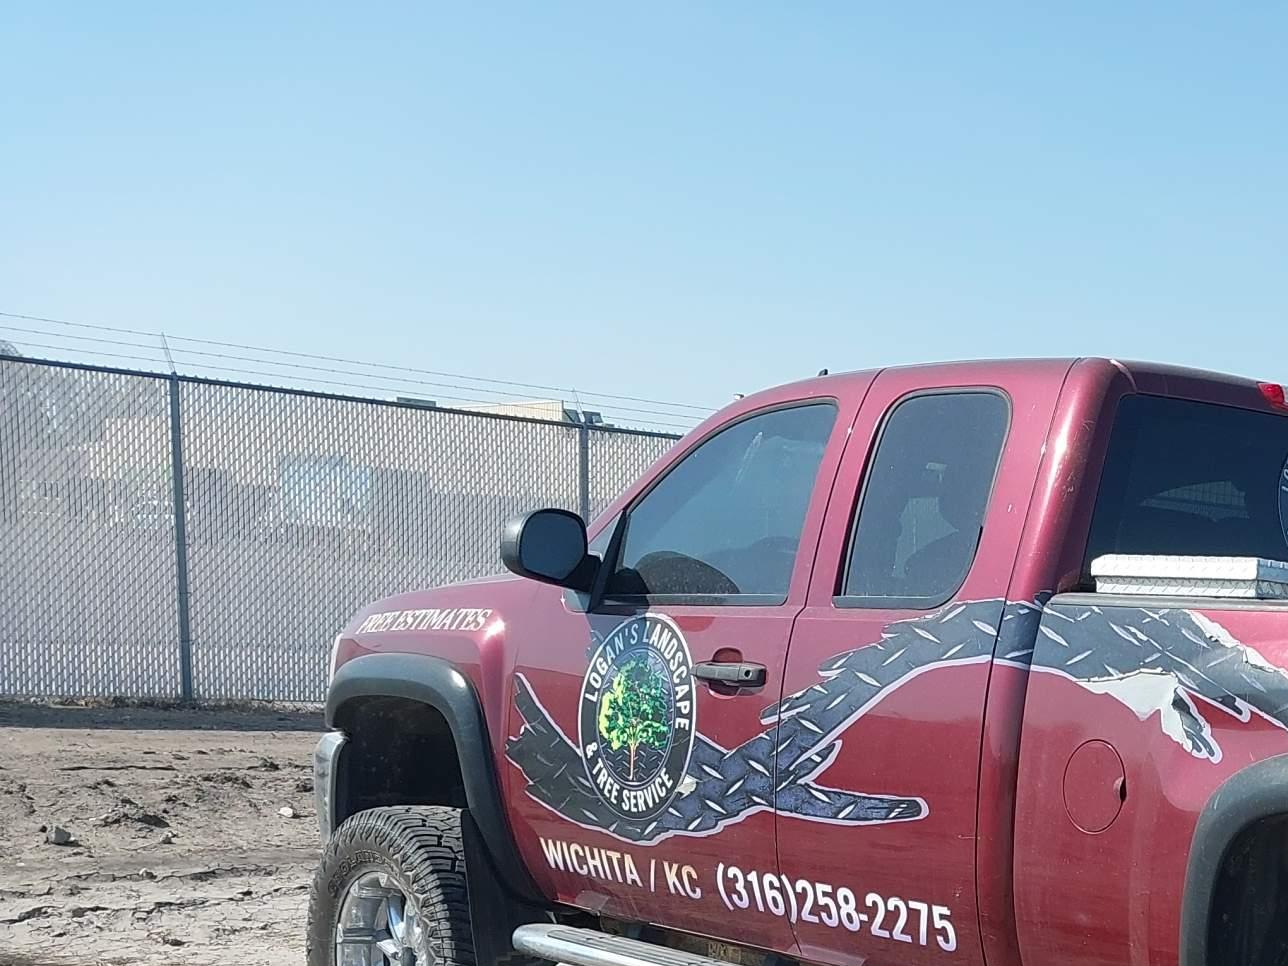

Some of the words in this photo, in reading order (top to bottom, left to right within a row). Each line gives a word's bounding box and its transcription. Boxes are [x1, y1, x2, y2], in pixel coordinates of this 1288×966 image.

[355, 610, 401, 635] FREE
[391, 608, 492, 632] ESTIMATES
[584, 621, 640, 703] LOGAN'S
[643, 619, 690, 732] LANDSCAPE
[585, 743, 598, 758] &
[592, 760, 621, 805] TREE
[621, 767, 675, 812] SERVICE
[539, 836, 643, 888] WICHITA
[649, 857, 657, 893] /
[663, 862, 702, 900] KC
[716, 862, 957, 951] (316)258-2275
